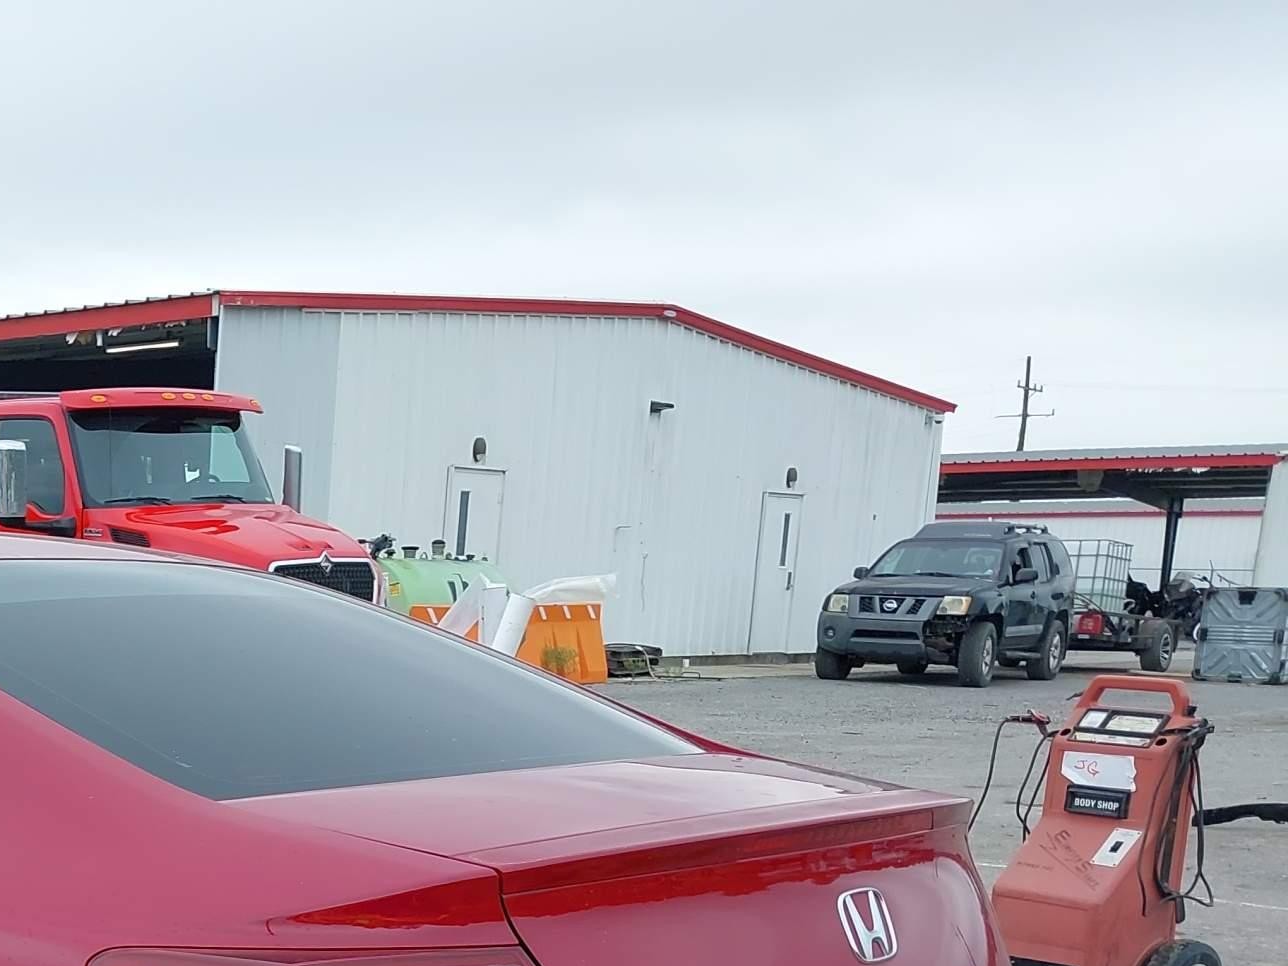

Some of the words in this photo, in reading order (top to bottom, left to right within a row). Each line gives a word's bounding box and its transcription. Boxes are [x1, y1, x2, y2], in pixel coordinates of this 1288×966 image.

[1073, 759, 1100, 777] JG
[1074, 797, 1096, 809] BODY
[1097, 799, 1120, 812] SHOP
